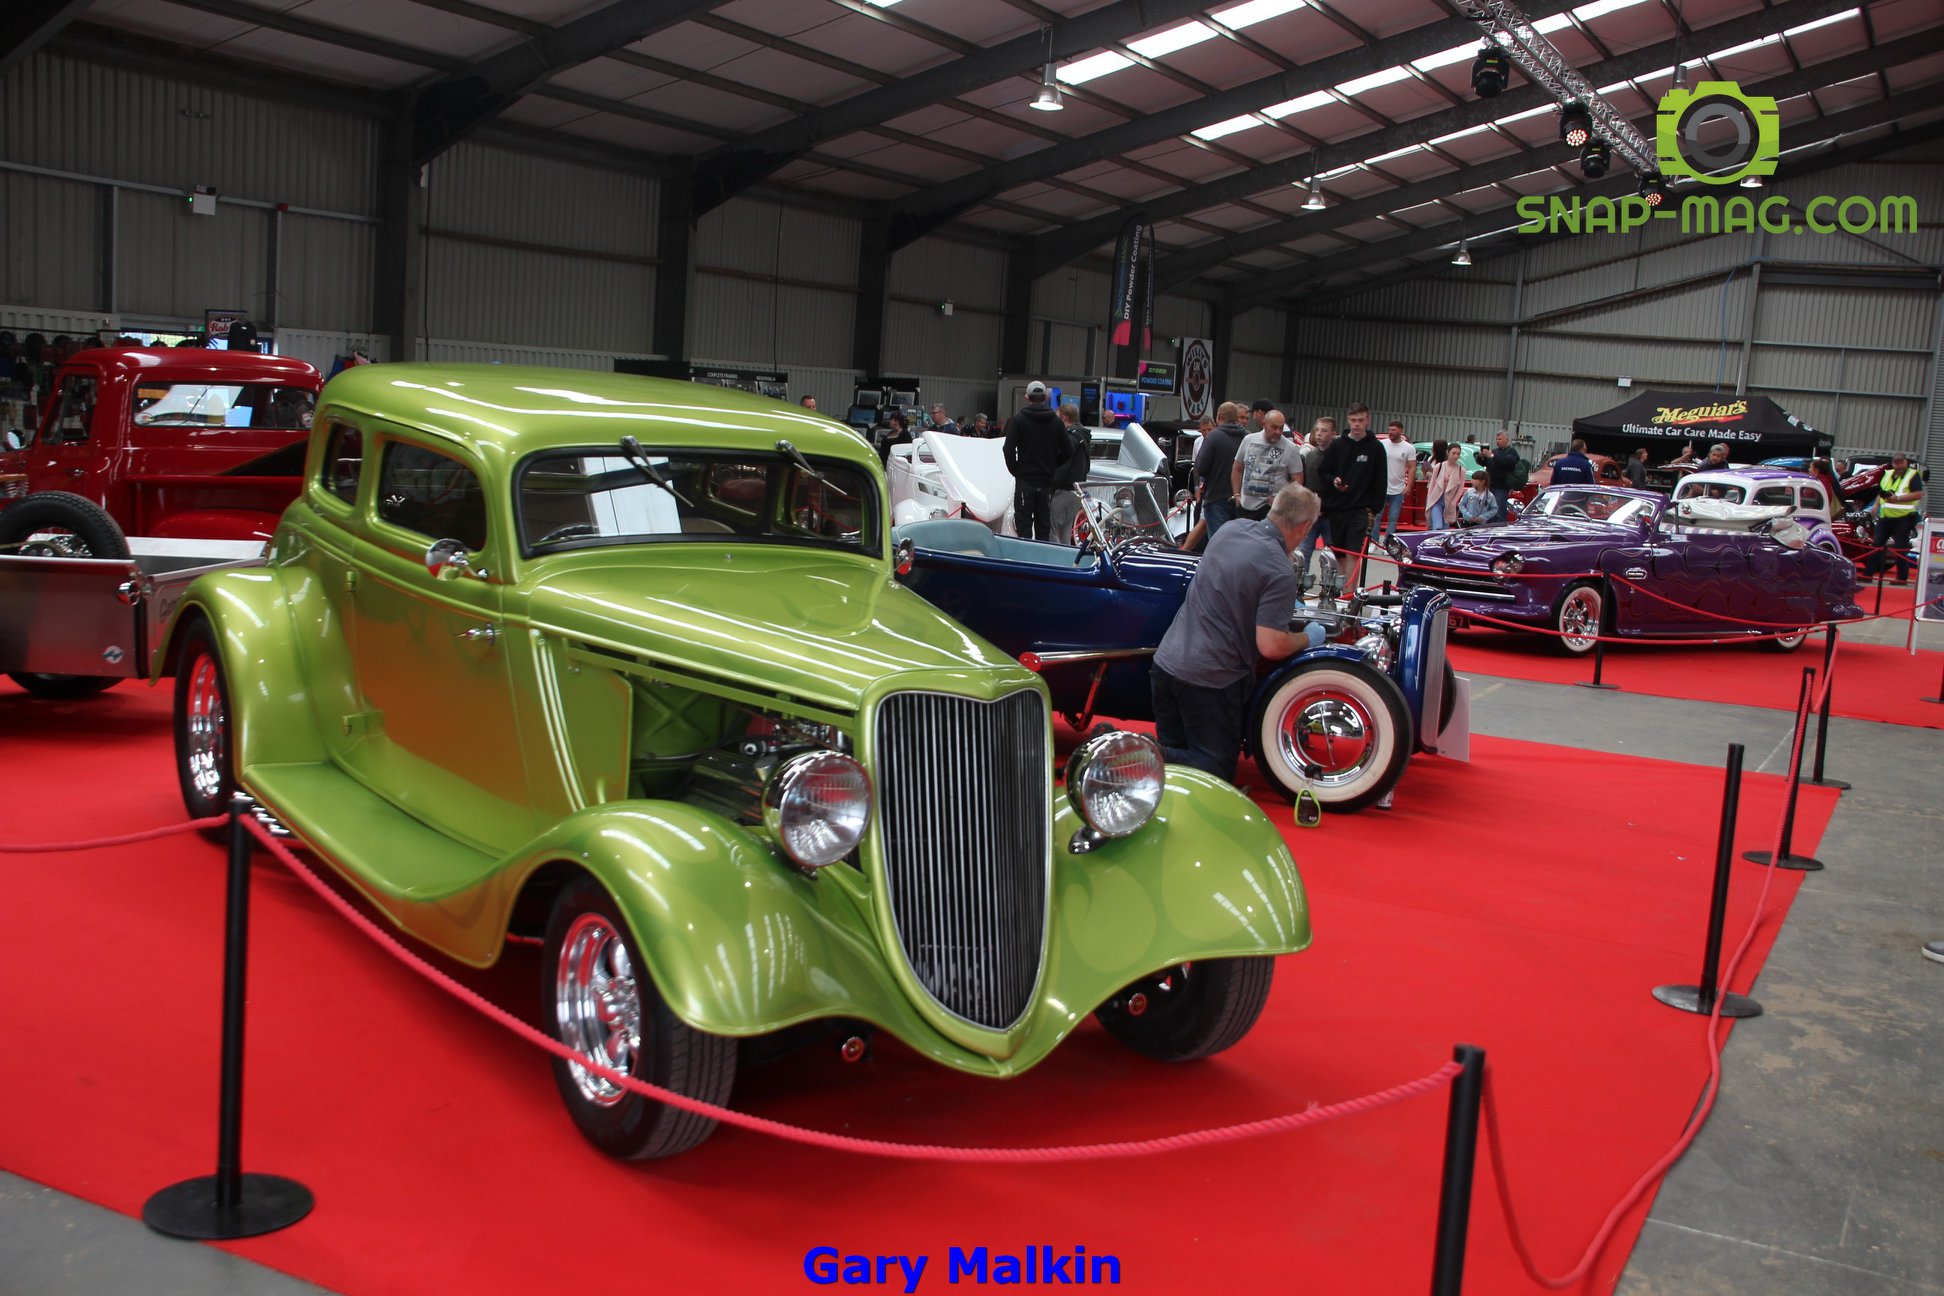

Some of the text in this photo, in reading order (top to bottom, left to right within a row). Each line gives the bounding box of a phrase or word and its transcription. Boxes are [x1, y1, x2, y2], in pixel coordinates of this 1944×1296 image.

[1123, 225, 1143, 320] DIY Powder Coating
[1187, 396, 1204, 414] WARS
[1651, 400, 1749, 424] Meguiar's
[1621, 423, 1762, 442] Ultimate Car Care Made Easy
